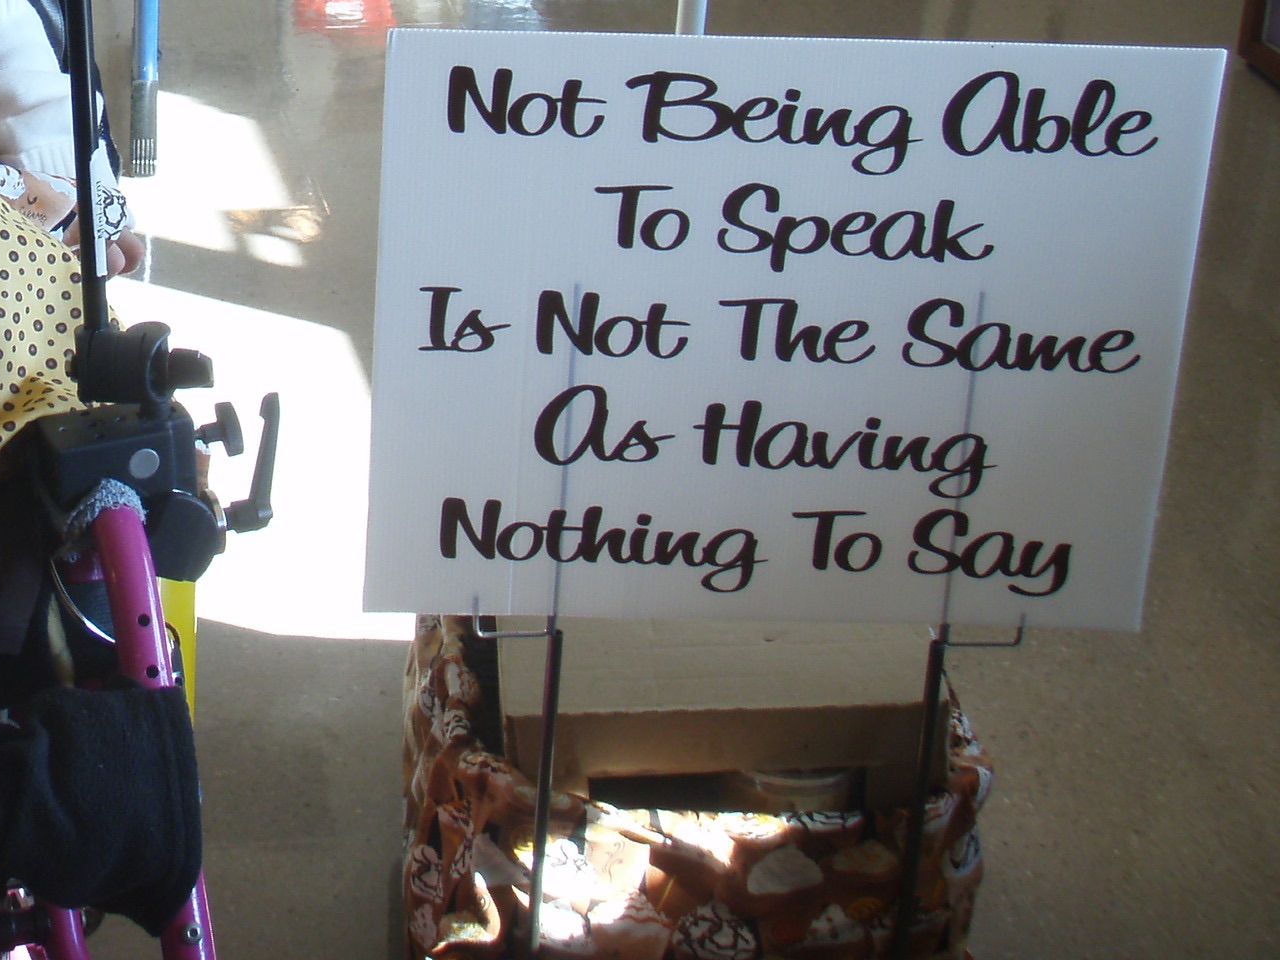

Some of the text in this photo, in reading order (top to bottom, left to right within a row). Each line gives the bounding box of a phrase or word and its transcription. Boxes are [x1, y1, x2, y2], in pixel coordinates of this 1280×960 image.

[447, 66, 1158, 175] Not Being Able
[96, 181, 105, 239] Mini-Arm
[595, 183, 994, 272] To Speak
[419, 286, 1140, 373] Is Not The Same
[534, 385, 997, 499] As Having
[439, 498, 1073, 595] Nothing To Say
